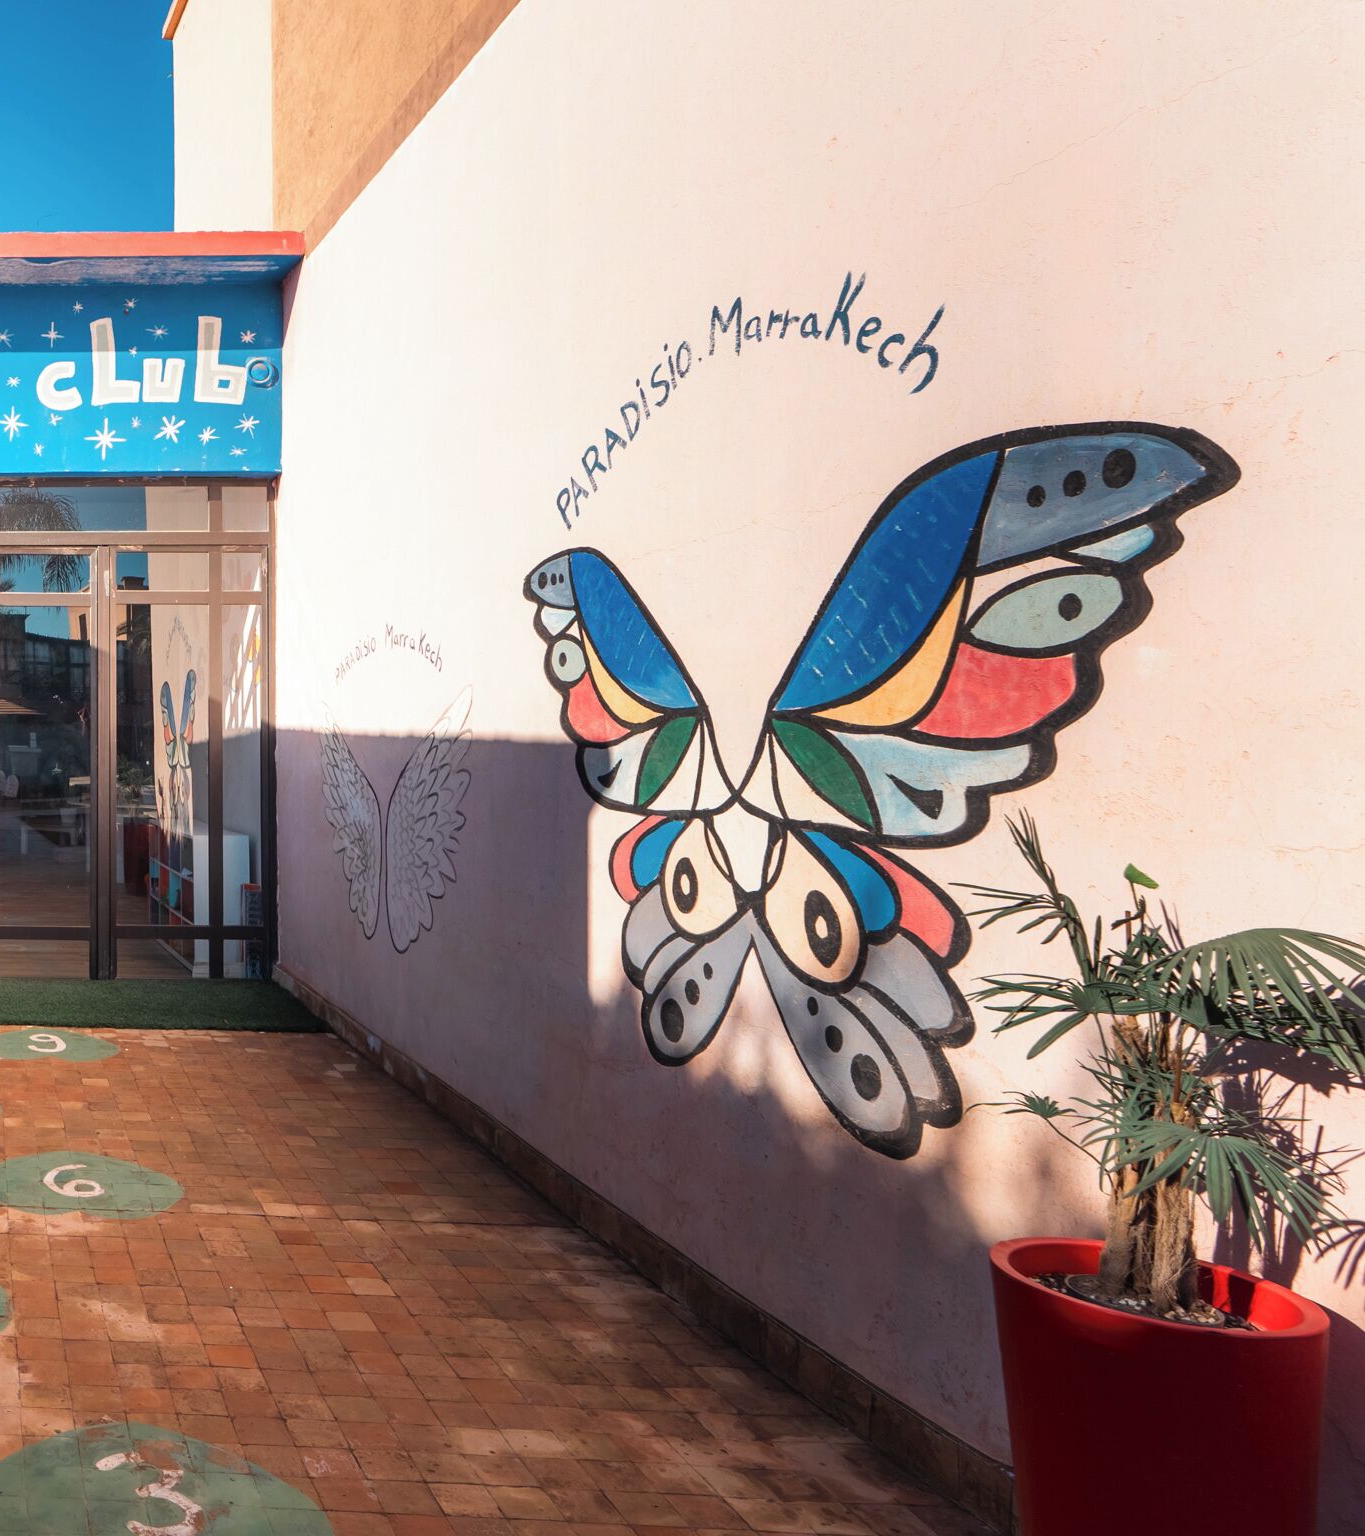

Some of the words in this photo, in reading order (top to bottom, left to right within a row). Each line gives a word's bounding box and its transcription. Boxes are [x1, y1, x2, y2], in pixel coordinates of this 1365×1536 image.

[27, 1034, 67, 1053] 9
[43, 1164, 105, 1196] 6
[94, 1452, 204, 1536] 3
